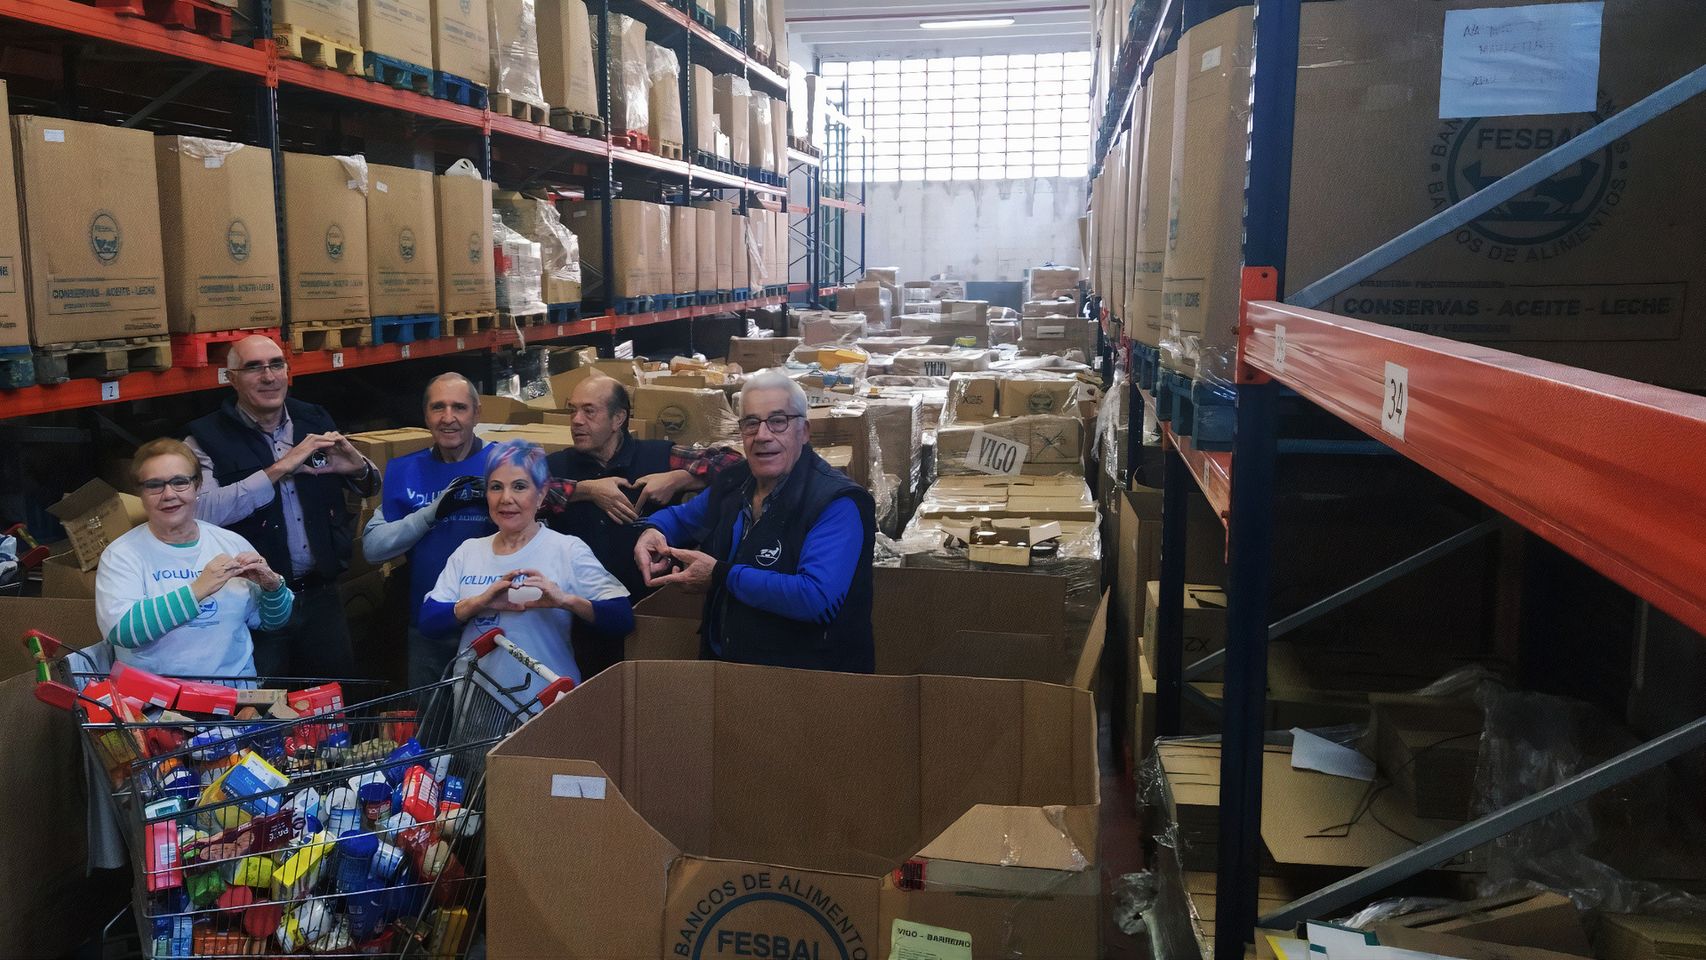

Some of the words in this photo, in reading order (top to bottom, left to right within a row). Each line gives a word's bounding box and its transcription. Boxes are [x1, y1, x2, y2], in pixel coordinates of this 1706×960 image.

[1477, 127, 1578, 150] FESBA
[1524, 178, 1627, 263] ALIMENTOS
[1343, 297, 1480, 317] CONSERVAS
[1494, 297, 1581, 317] ACEITE
[1600, 297, 1671, 316] LECHE
[1386, 377, 1404, 424] 34
[980, 436, 1018, 473] VIGO
[673, 879, 738, 957] BANCOS
[741, 872, 772, 891] DE
[777, 875, 869, 960] ALIMENTO
[896, 927, 918, 938] VIGO
